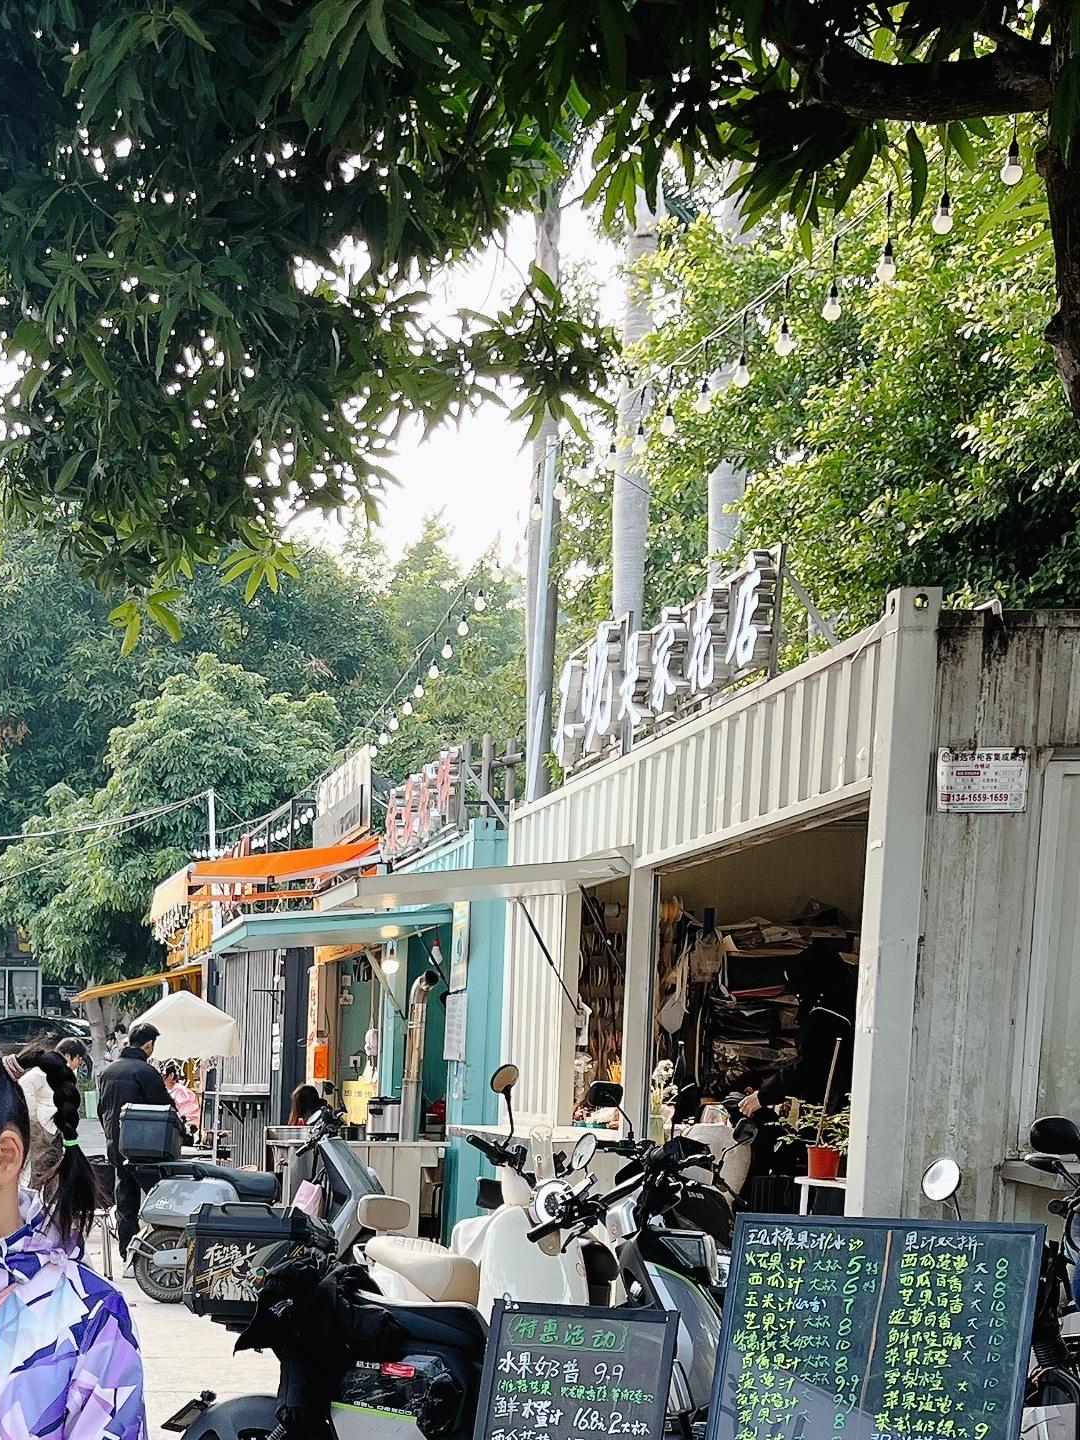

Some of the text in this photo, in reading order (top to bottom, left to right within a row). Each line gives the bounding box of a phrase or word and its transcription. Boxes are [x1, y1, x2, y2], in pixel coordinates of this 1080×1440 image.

[951, 793, 1009, 802] 134-1659-1659
[203, 1241, 258, 1268] 在路上
[905, 1231, 984, 1261] 果汁双拼
[813, 1259, 842, 1272] 大杯
[846, 1256, 866, 1275] 5
[900, 1252, 969, 1274] 西瓜菠萝
[748, 1272, 804, 1295] 西瓜汁
[808, 1279, 838, 1293] 大杯
[842, 1276, 859, 1295] 6
[899, 1271, 963, 1293] 西瓜百香
[992, 1281, 1007, 1299] 8
[842, 1299, 855, 1315] 7
[990, 1300, 1006, 1312] 10
[803, 1315, 831, 1329] 大杯
[837, 1317, 853, 1336] 8
[989, 1317, 1005, 1328] 10
[514, 1318, 617, 1348] 特惠活动
[988, 1335, 1004, 1346] 10
[835, 1339, 851, 1351] 10
[801, 1354, 831, 1369] 大杯
[834, 1356, 848, 1374] 8
[986, 1352, 1001, 1363] 10
[498, 1351, 624, 1387] 水果奶昔 9.9
[834, 1374, 859, 1393] 9.9
[983, 1377, 999, 1389] 10
[833, 1413, 845, 1430] 8
[974, 1422, 990, 1440] 9
